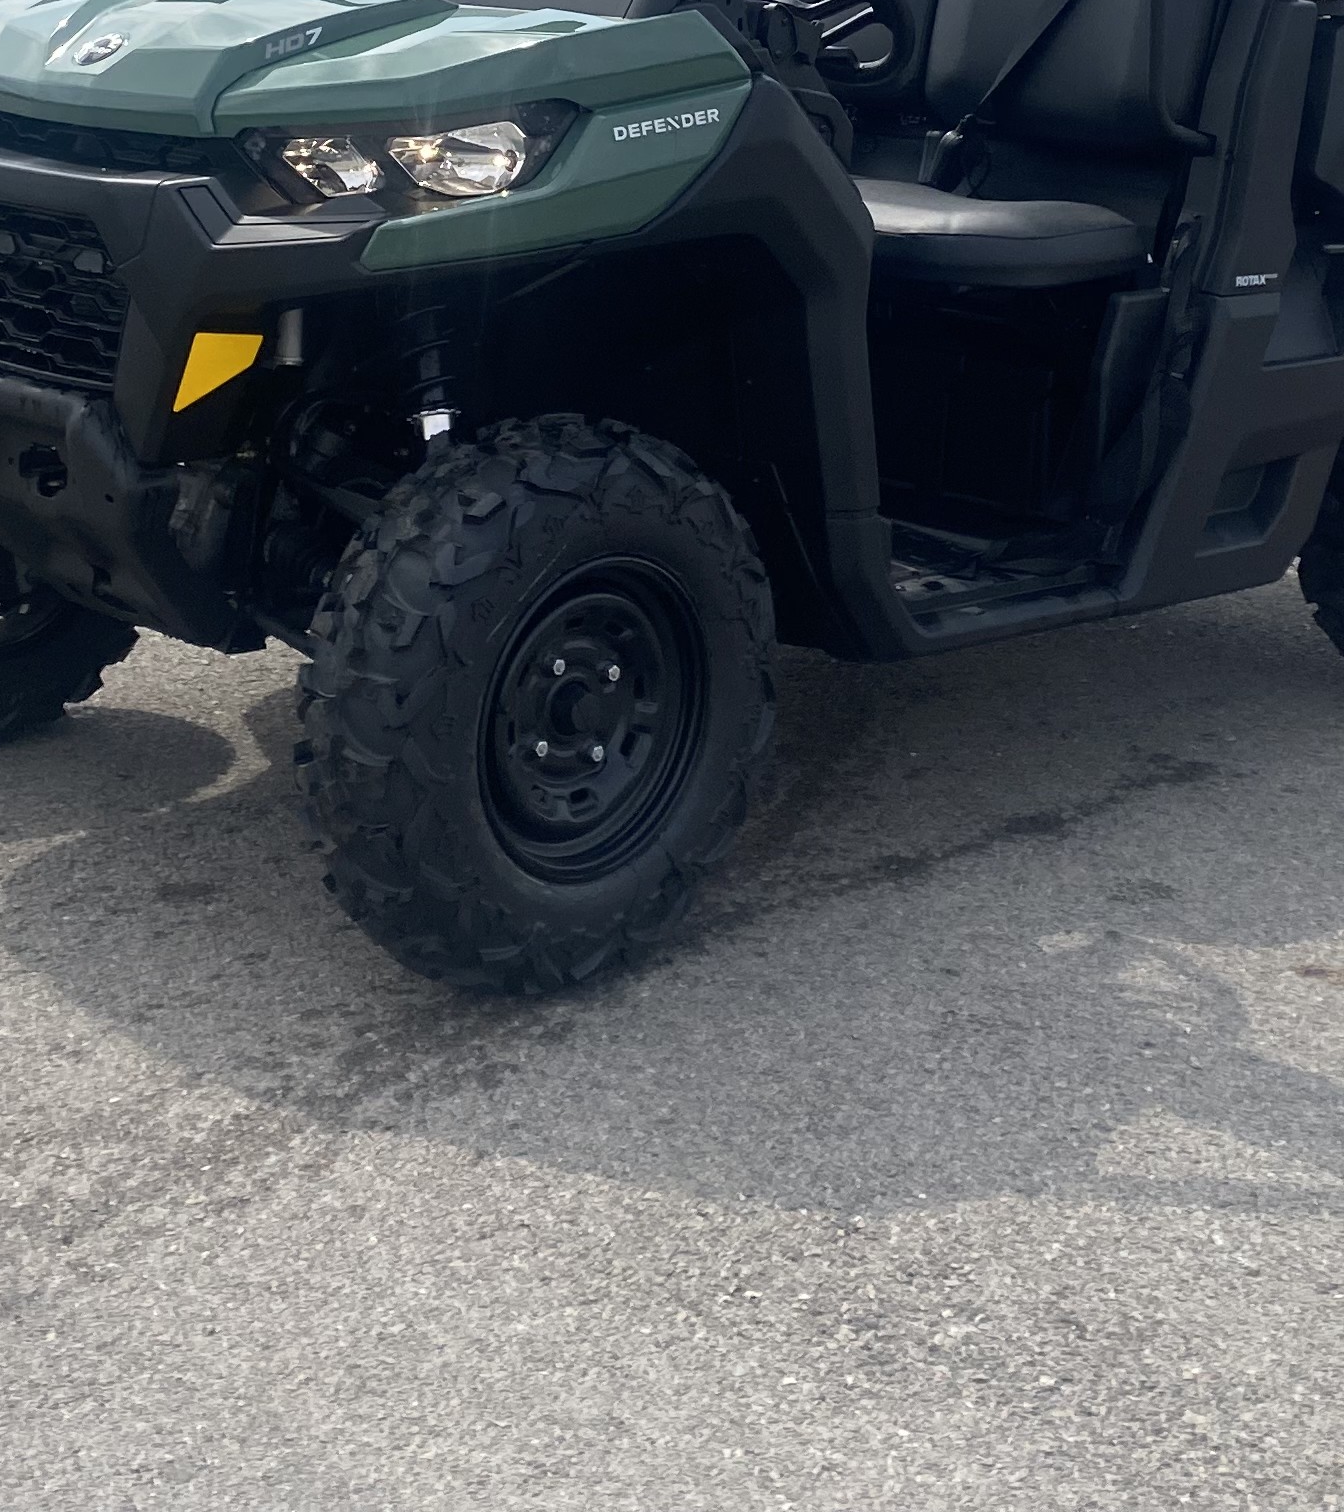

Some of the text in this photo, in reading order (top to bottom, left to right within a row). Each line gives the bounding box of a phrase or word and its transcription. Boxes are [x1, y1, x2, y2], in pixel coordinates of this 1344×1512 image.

[265, 27, 323, 59] HD7
[613, 108, 720, 141] DEFENDER
[1235, 274, 1267, 287] ROTAX
